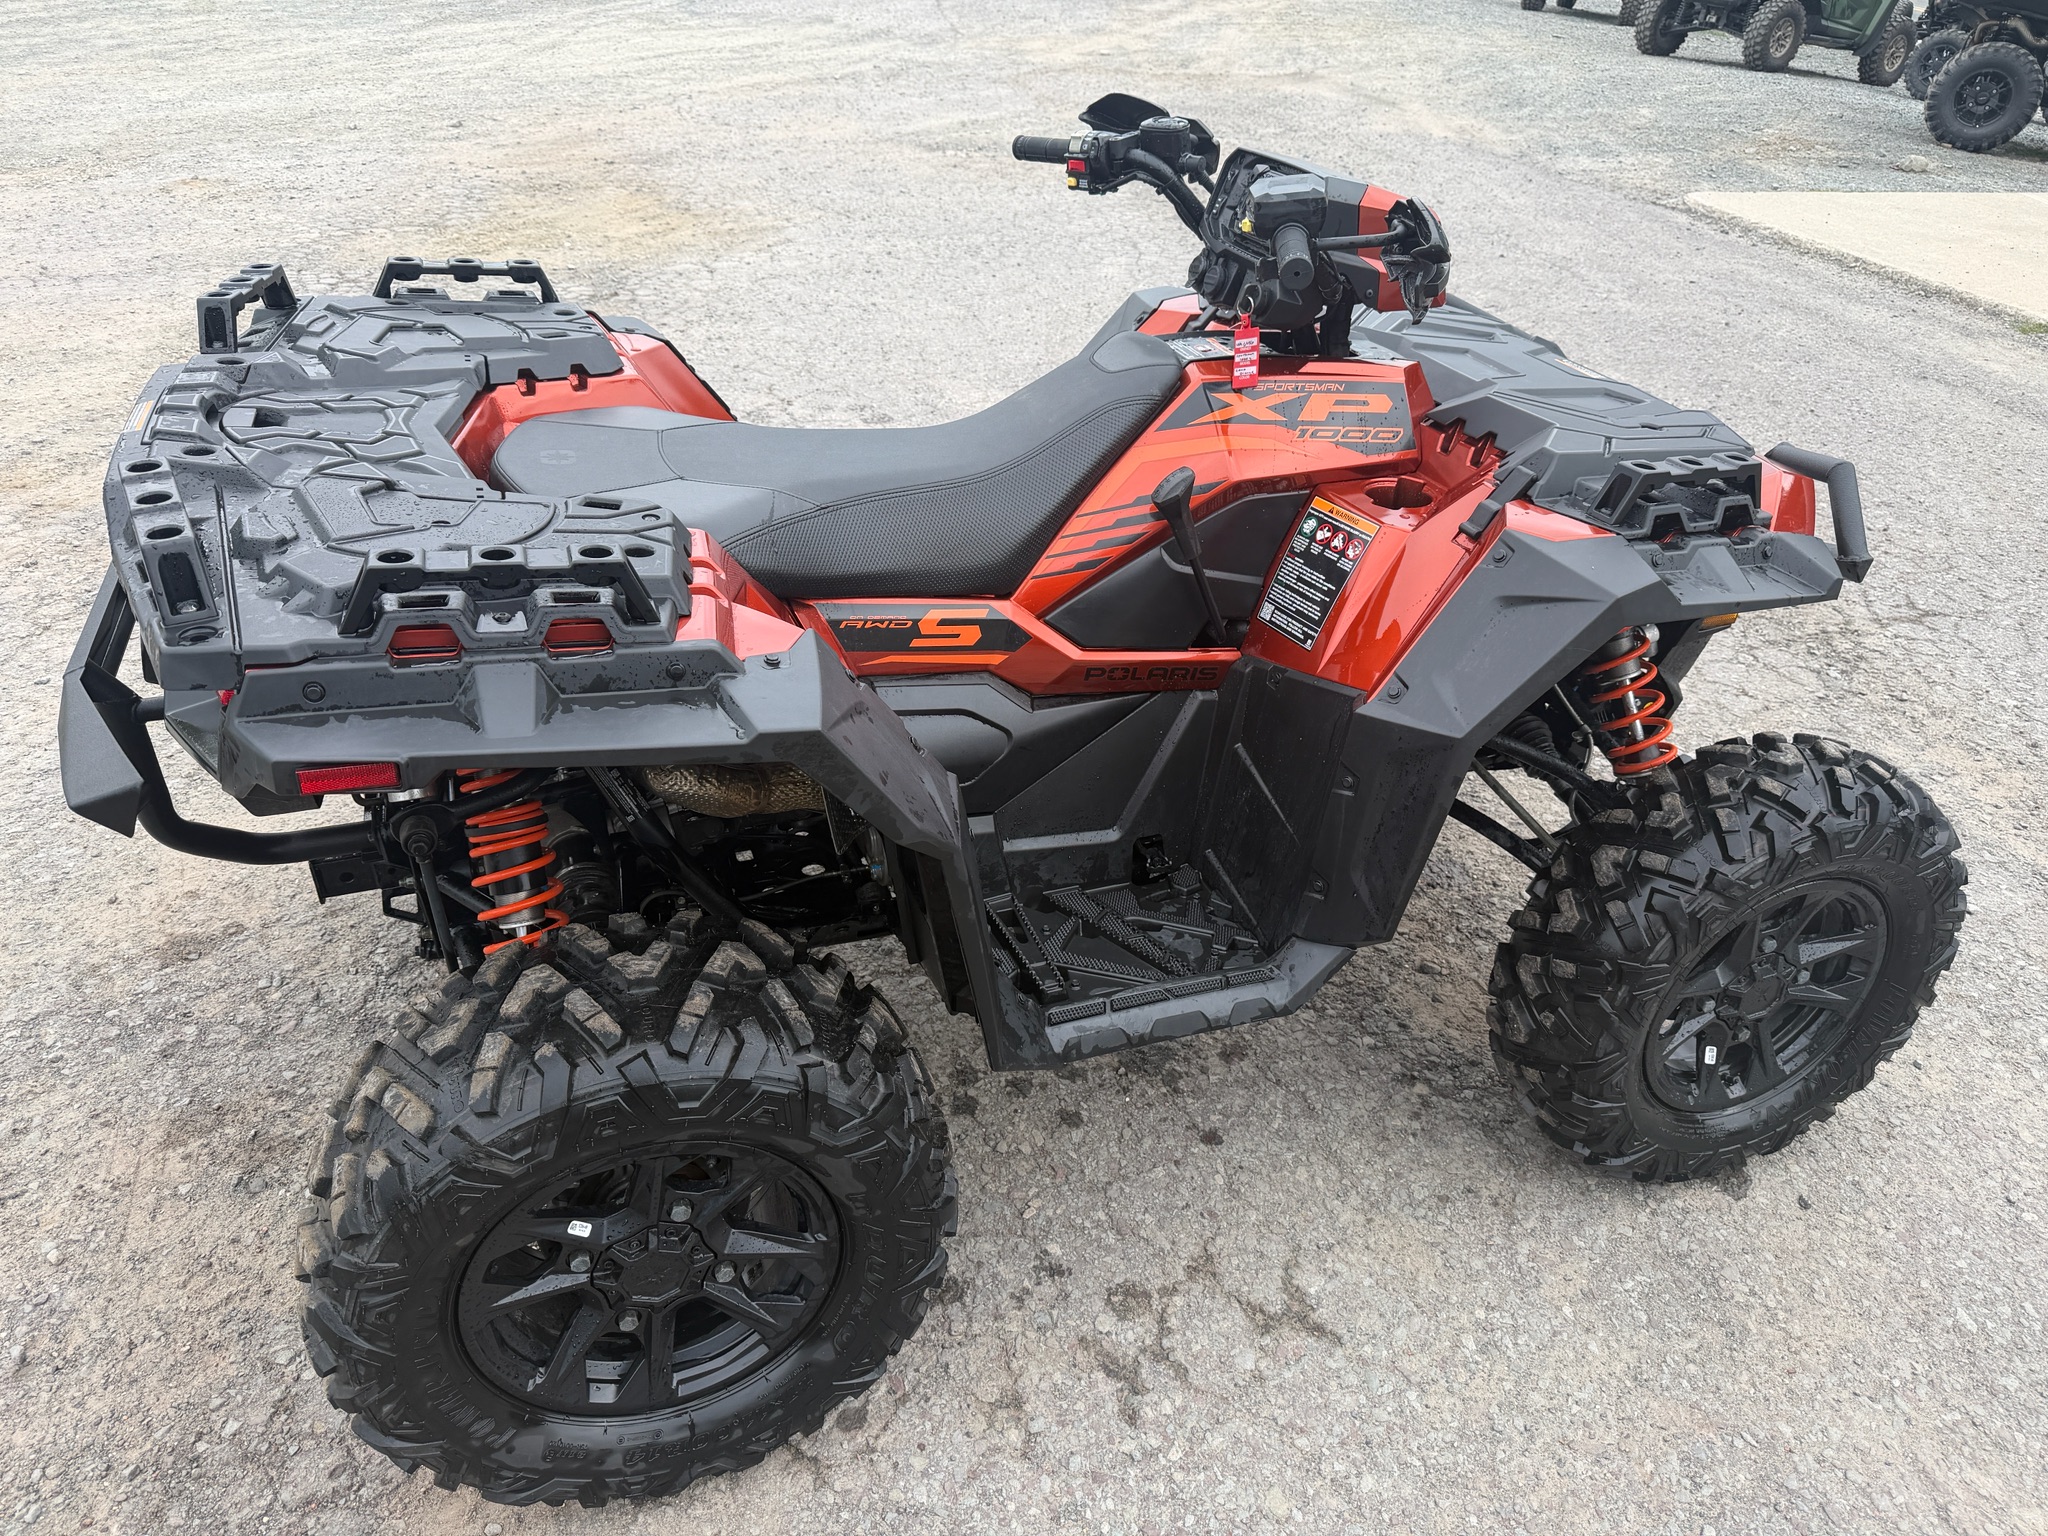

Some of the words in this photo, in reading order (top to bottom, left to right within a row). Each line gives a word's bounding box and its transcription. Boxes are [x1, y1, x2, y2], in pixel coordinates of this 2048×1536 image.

[1253, 383, 1346, 392] SPORTSMAN
[1187, 393, 1394, 425] XP
[1294, 426, 1404, 444] 1000
[1335, 508, 1360, 526] WARNING
[839, 620, 913, 629] AWD
[908, 608, 990, 648] S
[1083, 666, 1220, 682] POLARIS
